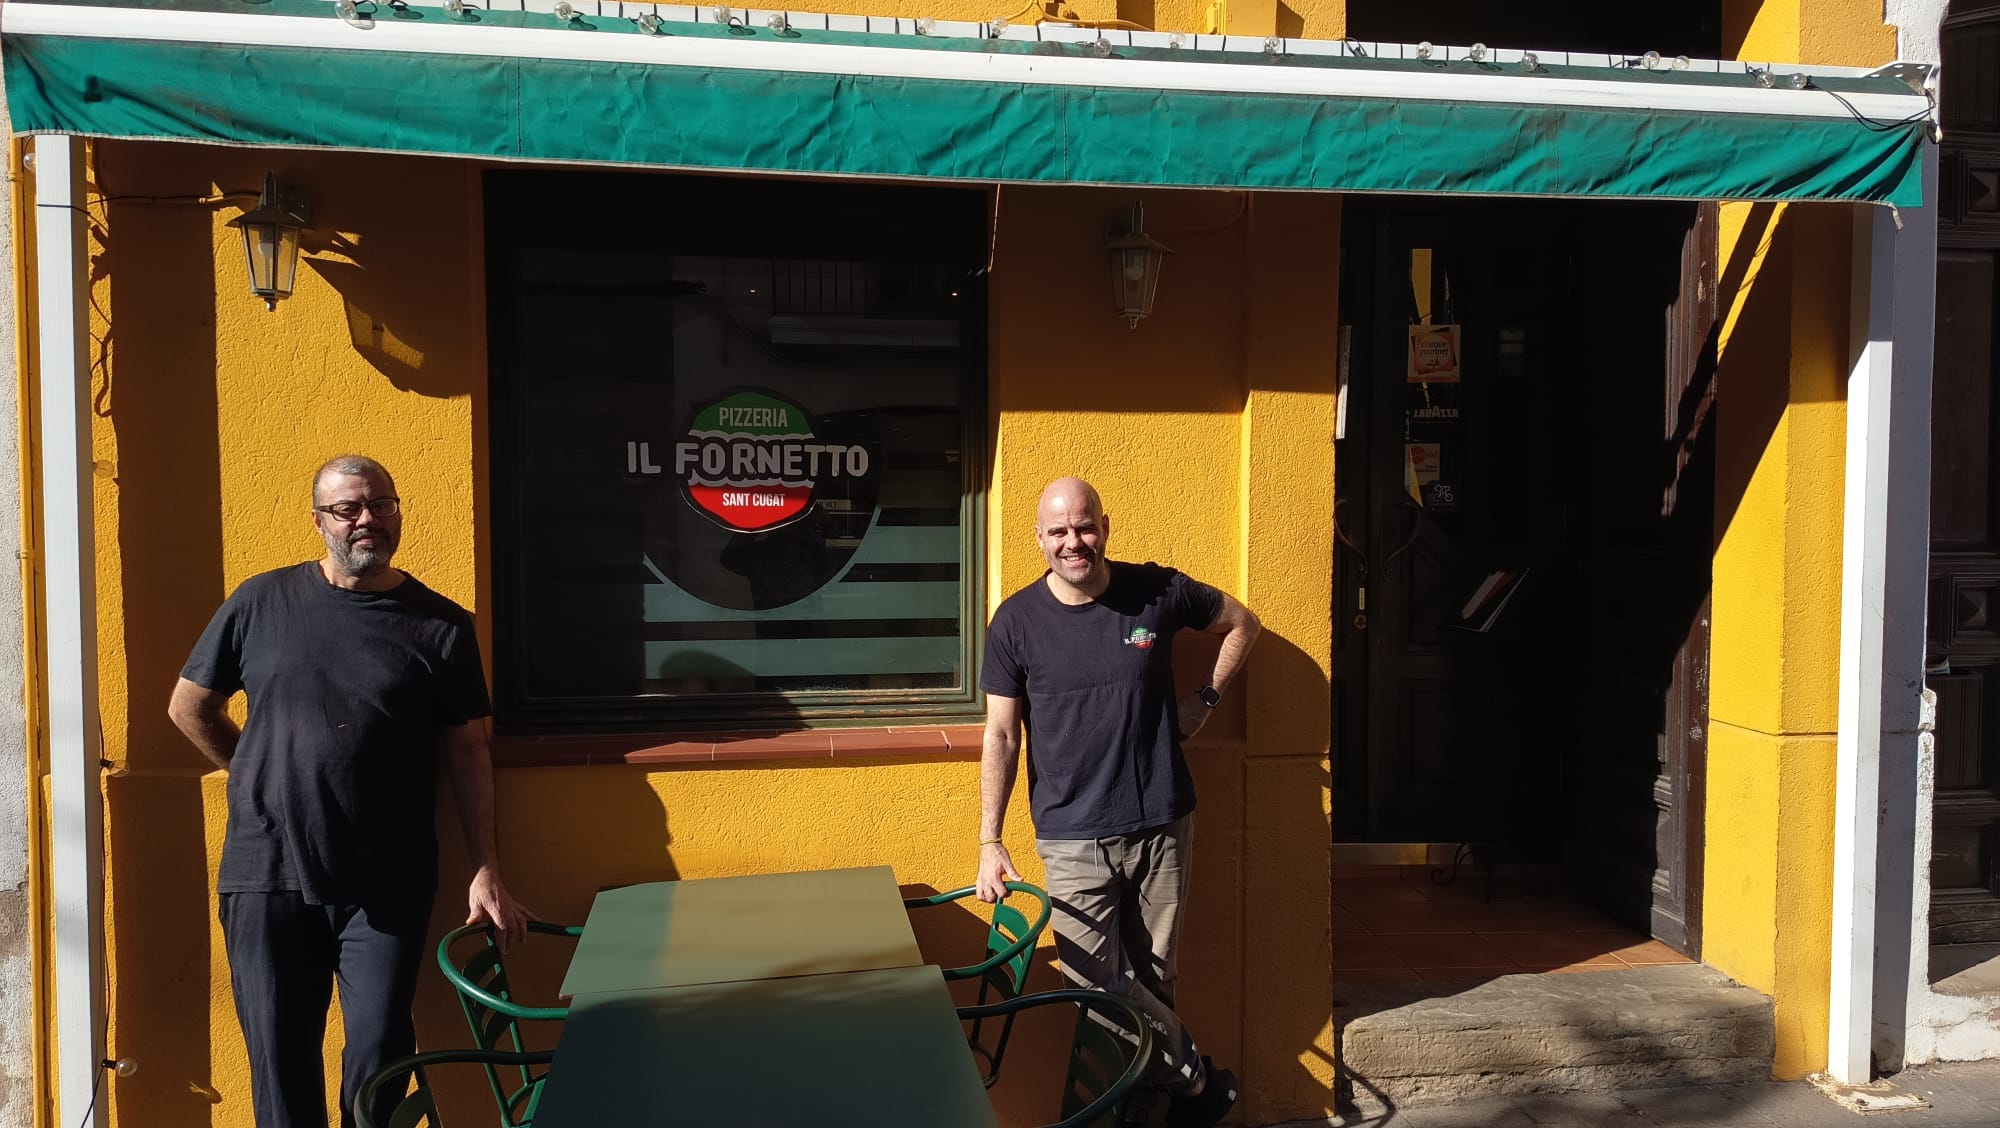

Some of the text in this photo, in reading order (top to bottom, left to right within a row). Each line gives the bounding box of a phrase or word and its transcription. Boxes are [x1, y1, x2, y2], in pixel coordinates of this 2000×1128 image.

[1419, 347, 1449, 357] gourmet
[719, 407, 788, 427] PIZZERIA
[1413, 405, 1459, 418] LAVAZZA
[627, 441, 869, 477] IL FORNETTO
[723, 493, 786, 507] SANT CUGAT
